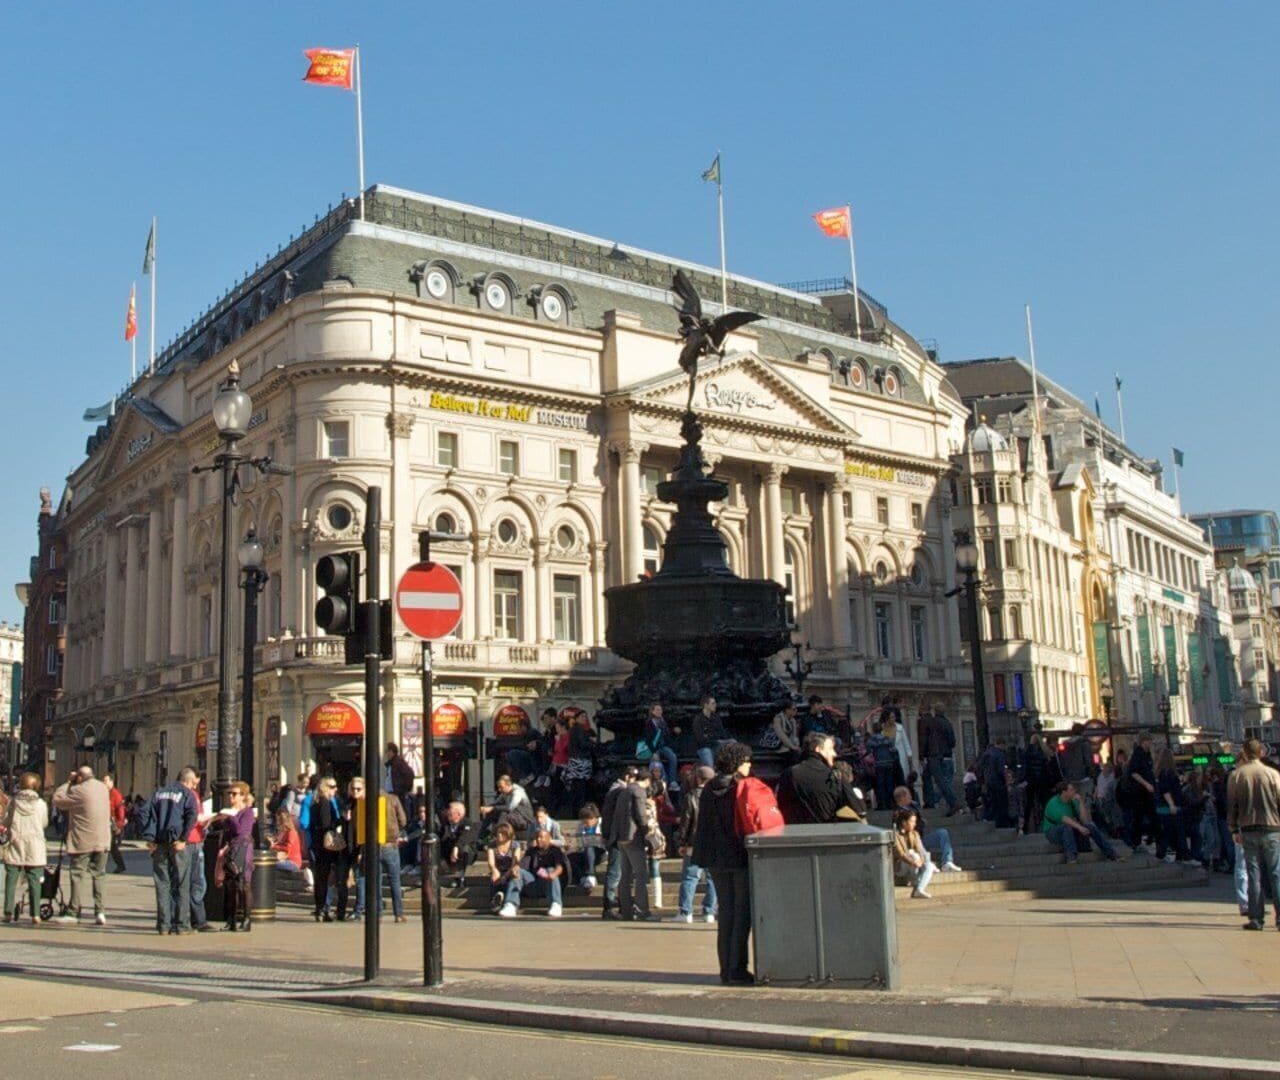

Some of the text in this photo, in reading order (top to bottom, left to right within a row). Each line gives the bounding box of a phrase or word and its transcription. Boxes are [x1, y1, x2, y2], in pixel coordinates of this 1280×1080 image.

[429, 392, 588, 429] Believe It or Not! MUSEUM
